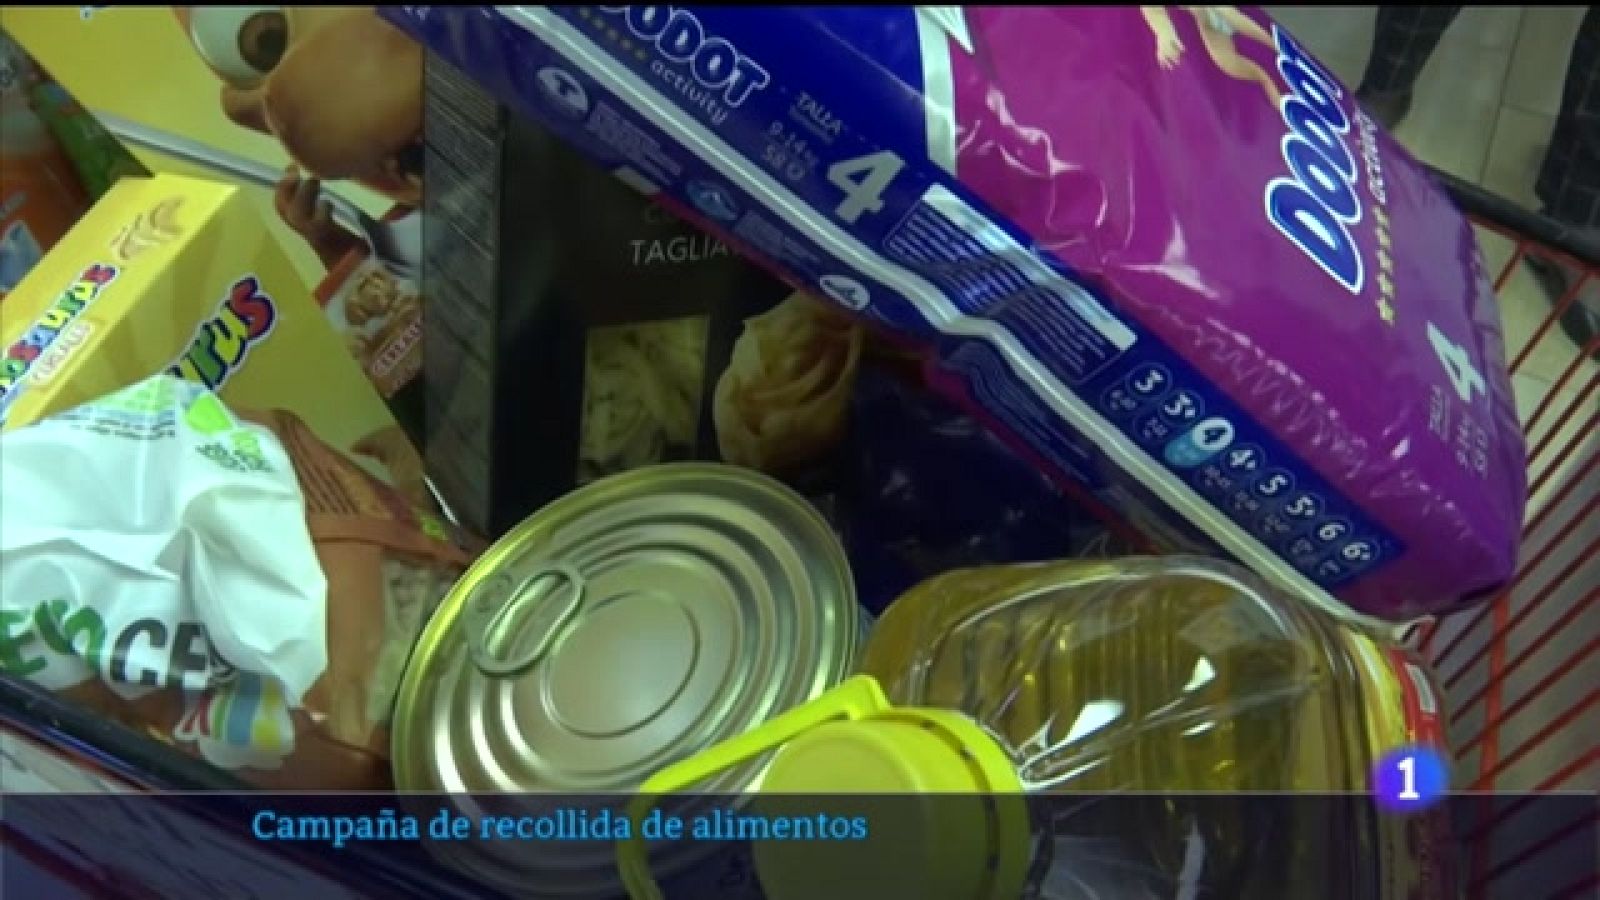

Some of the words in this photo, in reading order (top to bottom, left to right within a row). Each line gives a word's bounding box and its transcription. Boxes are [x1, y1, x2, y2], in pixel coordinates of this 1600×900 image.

[600, 5, 771, 108] ODOT
[651, 58, 728, 126] activity
[827, 150, 906, 225] 4
[629, 236, 738, 267] TAGLIA
[1427, 320, 1486, 403] 4
[1134, 368, 1164, 393] 3
[1201, 422, 1227, 446] 4
[1258, 473, 1289, 495] 5
[1318, 522, 1346, 541] 6
